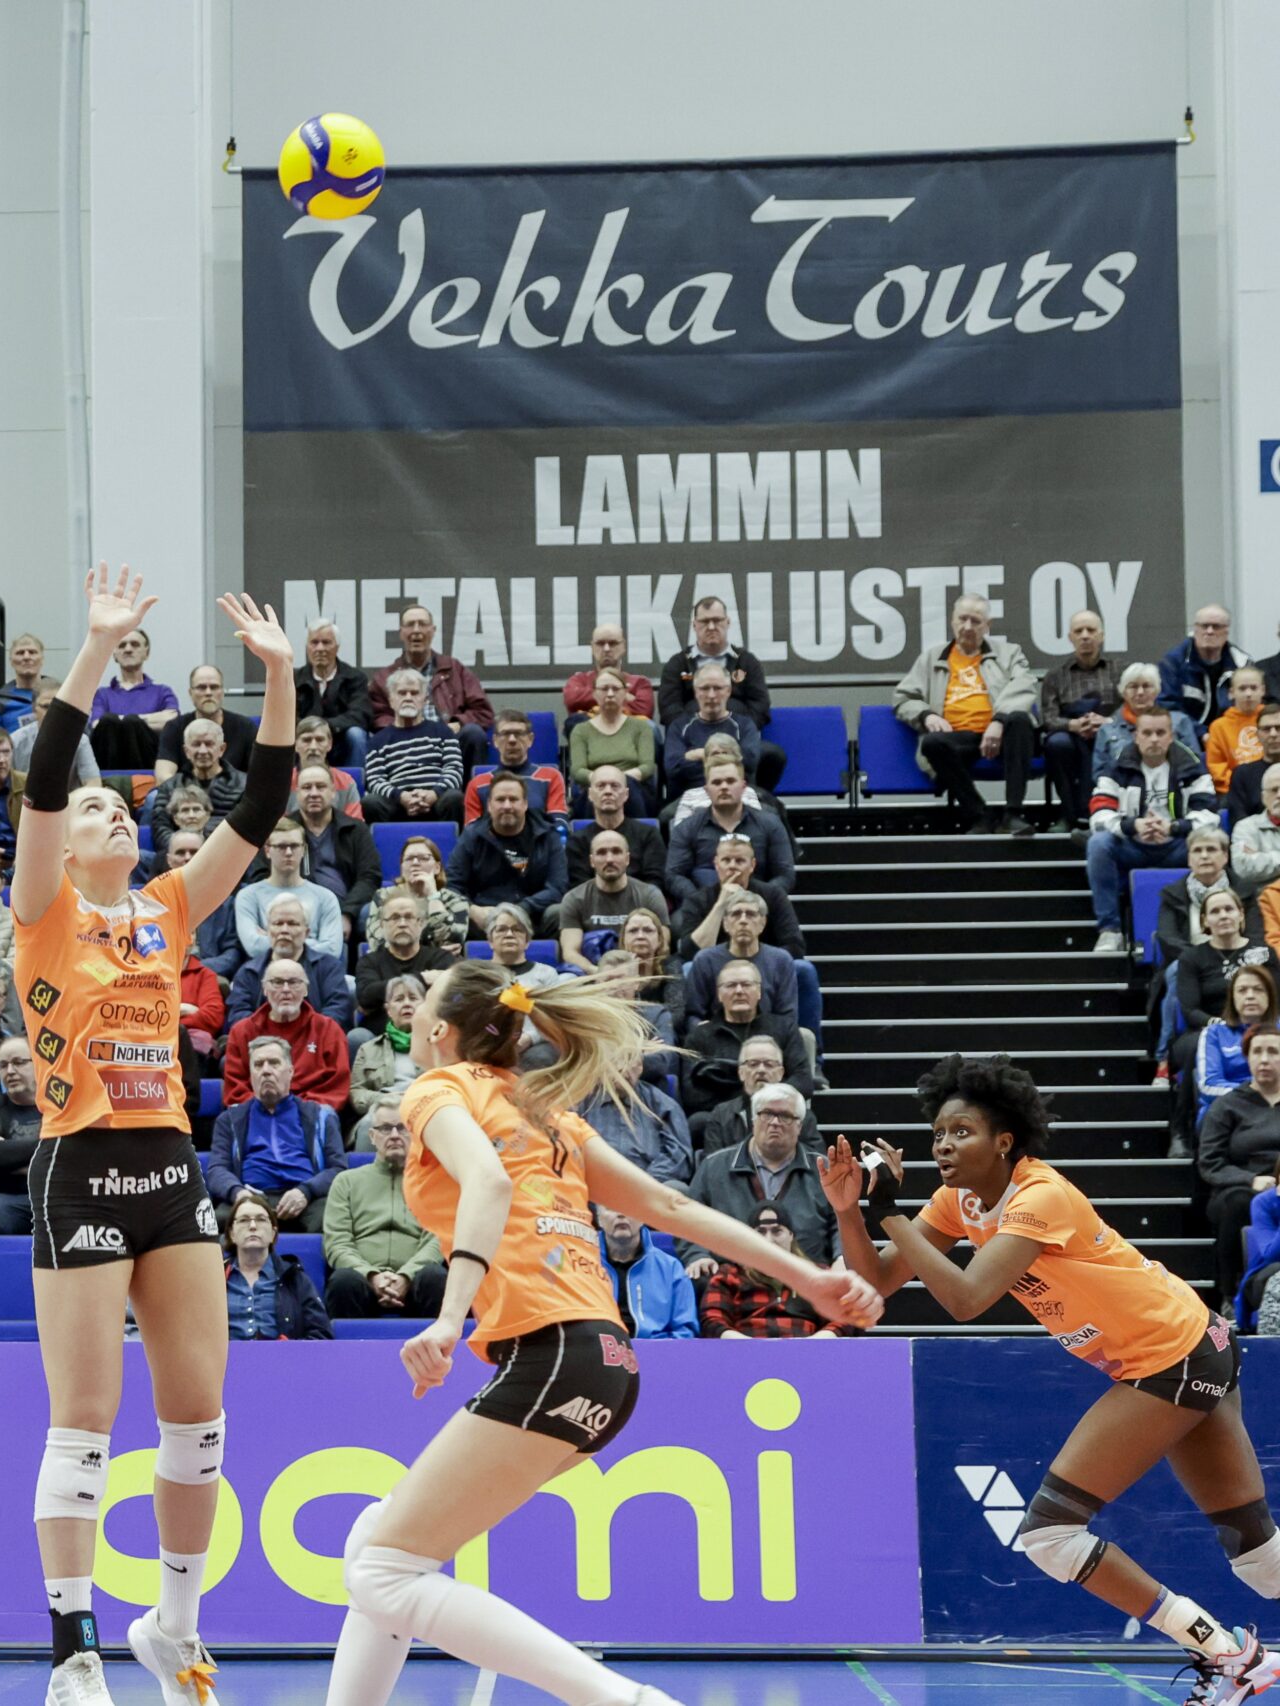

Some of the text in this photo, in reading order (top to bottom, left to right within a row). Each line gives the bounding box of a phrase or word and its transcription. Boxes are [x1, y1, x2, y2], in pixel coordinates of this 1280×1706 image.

[283, 194, 1137, 350] Vekka Tours
[533, 447, 882, 547] LAMMIN
[284, 561, 1143, 668] METALLIKALUSTE OY
[116, 1046, 170, 1063] NOHEVA
[88, 1164, 188, 1196] TNRak Oy
[61, 1225, 124, 1252] AKO
[545, 1395, 612, 1434] AKO
